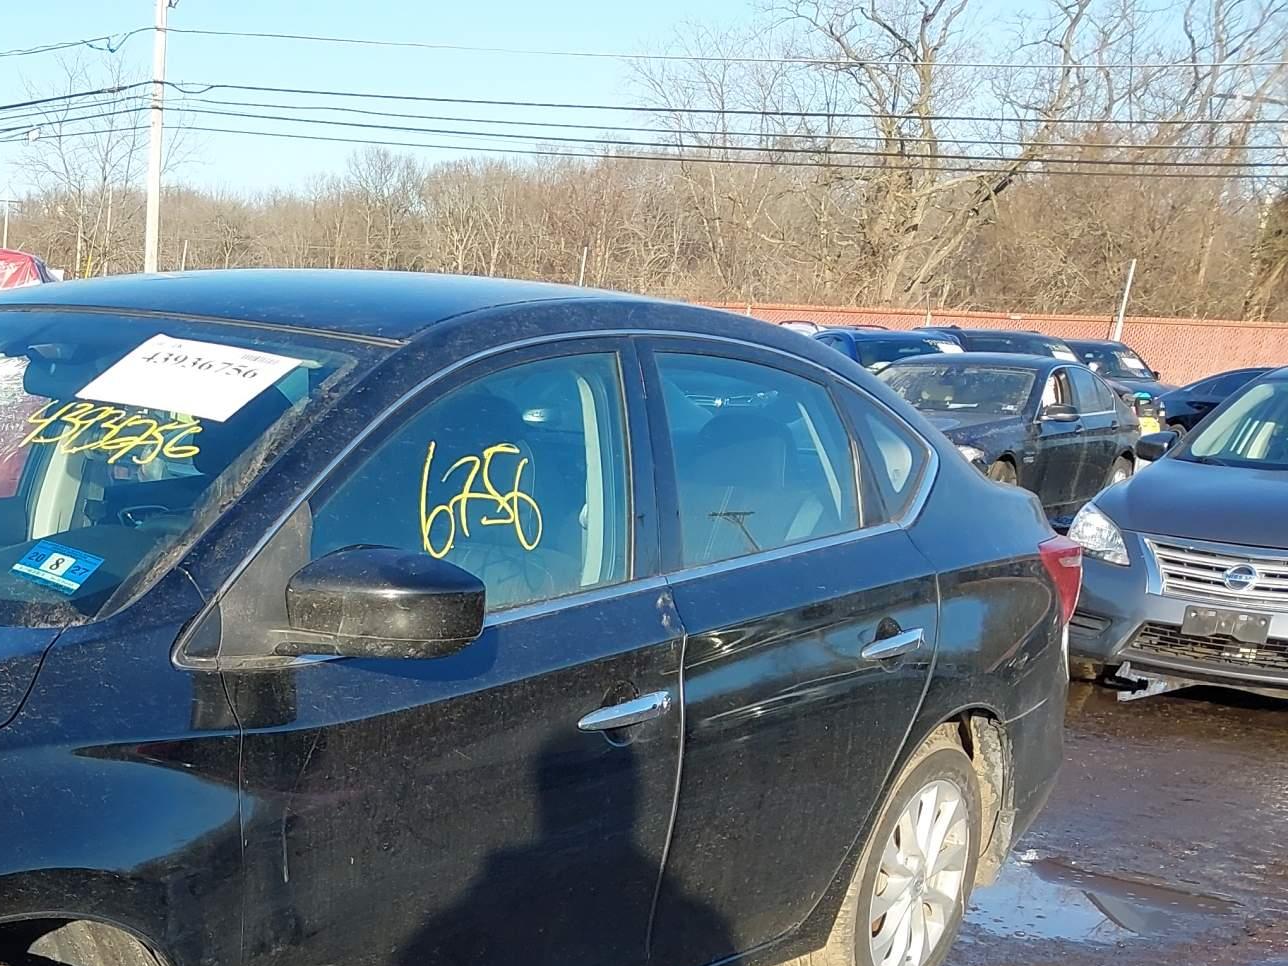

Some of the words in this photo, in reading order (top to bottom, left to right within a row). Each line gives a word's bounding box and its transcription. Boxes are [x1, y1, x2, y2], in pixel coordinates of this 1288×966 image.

[141, 351, 259, 380] 43936756
[420, 440, 543, 559] 6756
[28, 551, 46, 562] 20
[50, 558, 65, 570] 8
[71, 566, 89, 576] 27
